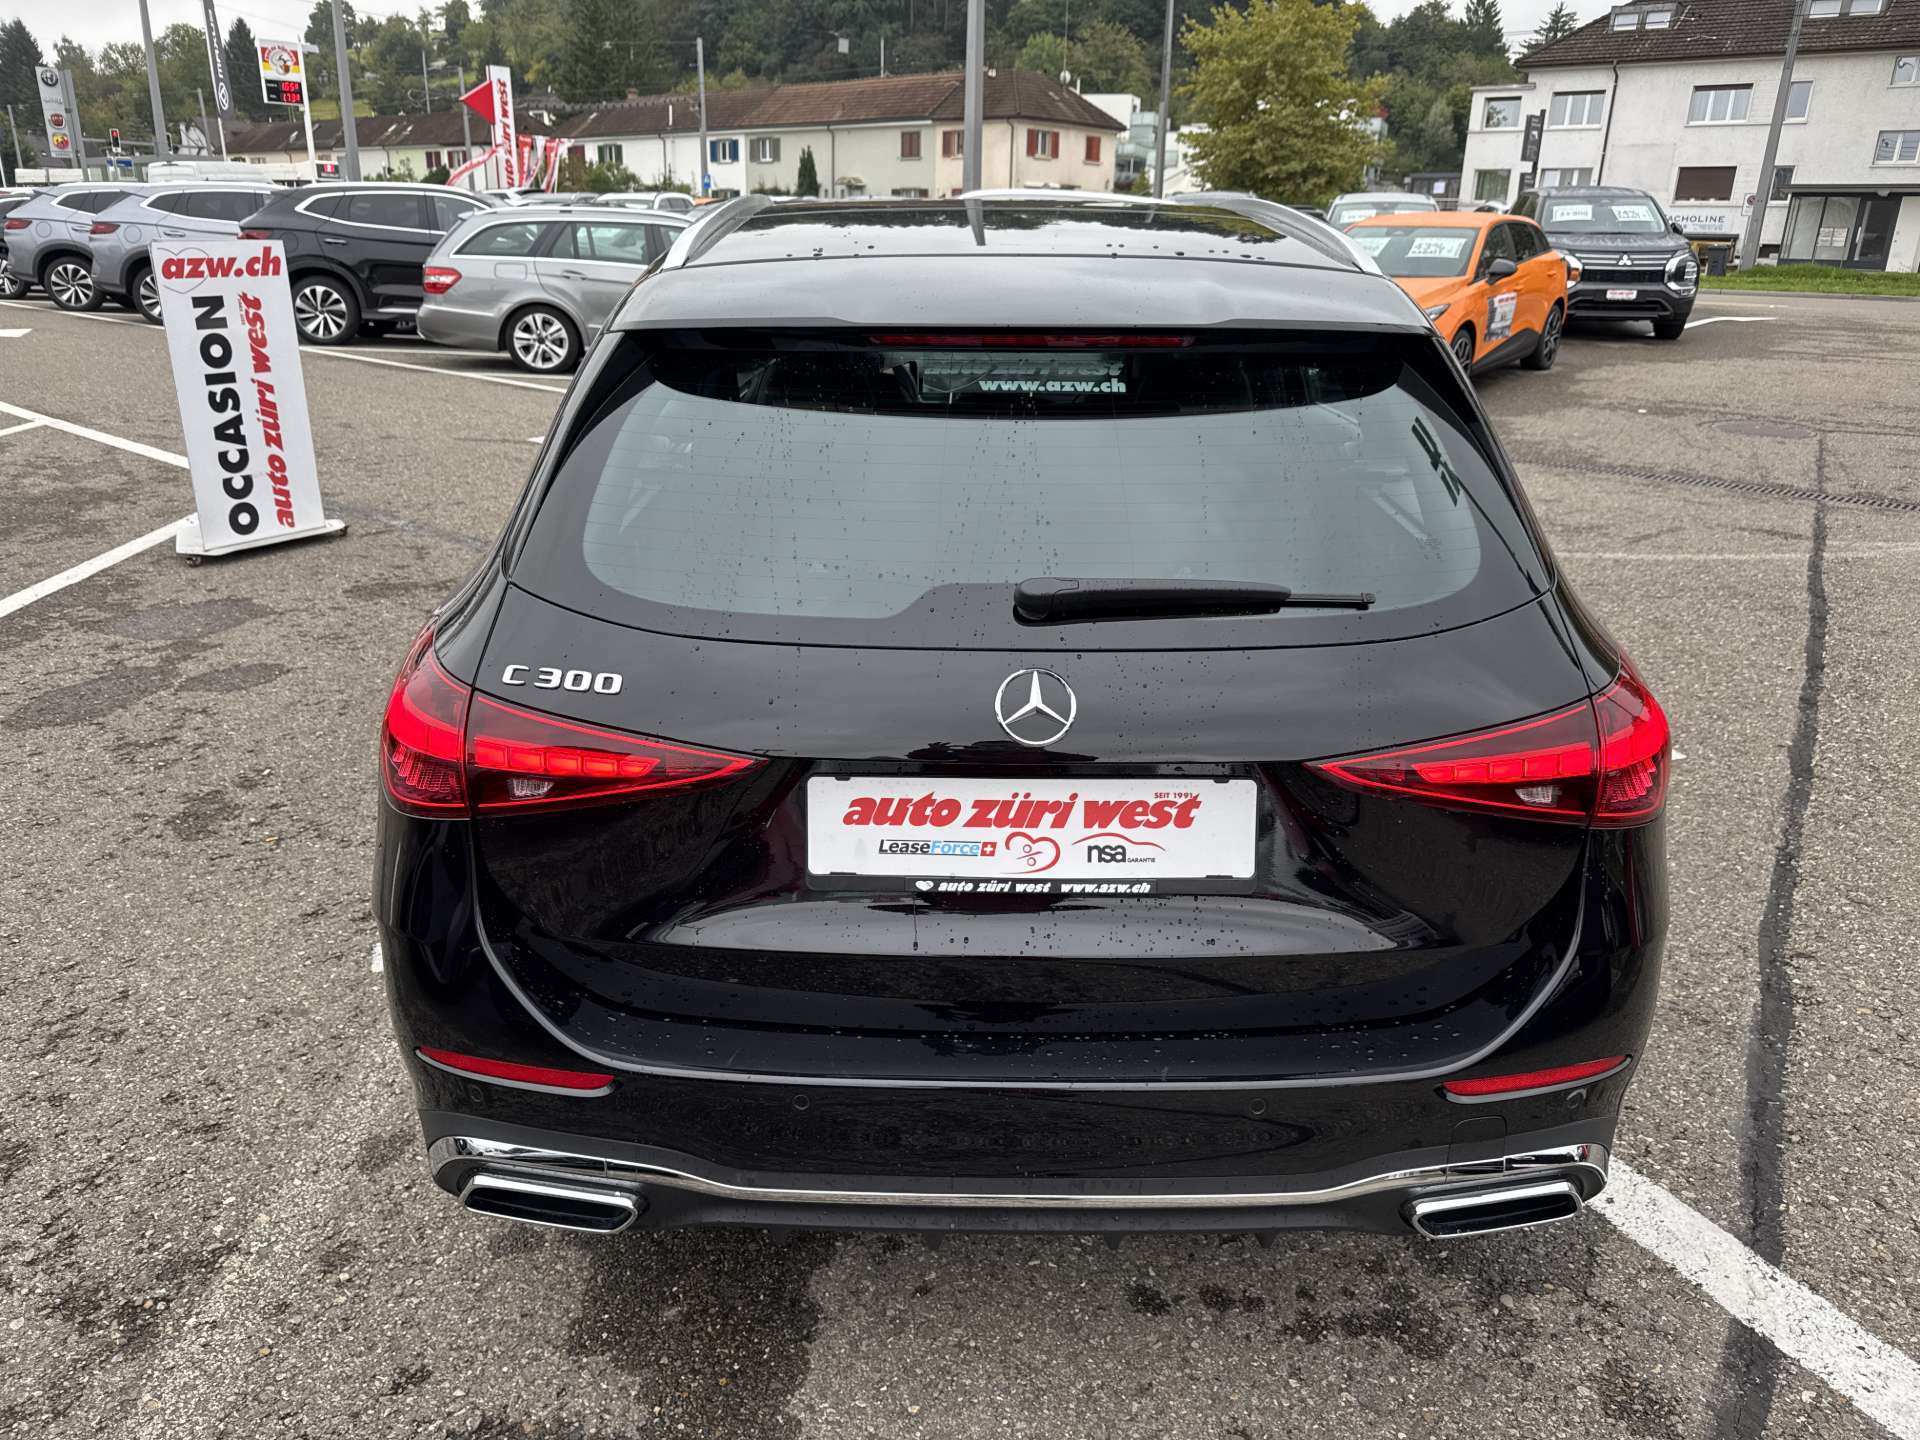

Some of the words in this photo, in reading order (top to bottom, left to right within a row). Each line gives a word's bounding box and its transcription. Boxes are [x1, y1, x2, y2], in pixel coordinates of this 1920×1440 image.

[162, 246, 282, 280] azw.ch
[238, 292, 273, 374] west
[978, 378, 1127, 393] www.azw.ch
[191, 295, 260, 536] OCCASION
[251, 378, 285, 452] züri
[267, 454, 296, 529] auto
[502, 664, 530, 686] C
[533, 667, 623, 695] 300
[842, 792, 963, 826] auto
[964, 791, 1078, 830] züri
[1083, 792, 1206, 830] west
[1154, 791, 1171, 799] SEIT
[878, 839, 980, 856] LeaseForce
[1087, 844, 1127, 864] nsa
[938, 881, 974, 893] auto
[976, 879, 1011, 893] züri
[1014, 881, 1051, 893] west
[1060, 881, 1151, 894] www.azw.ch
